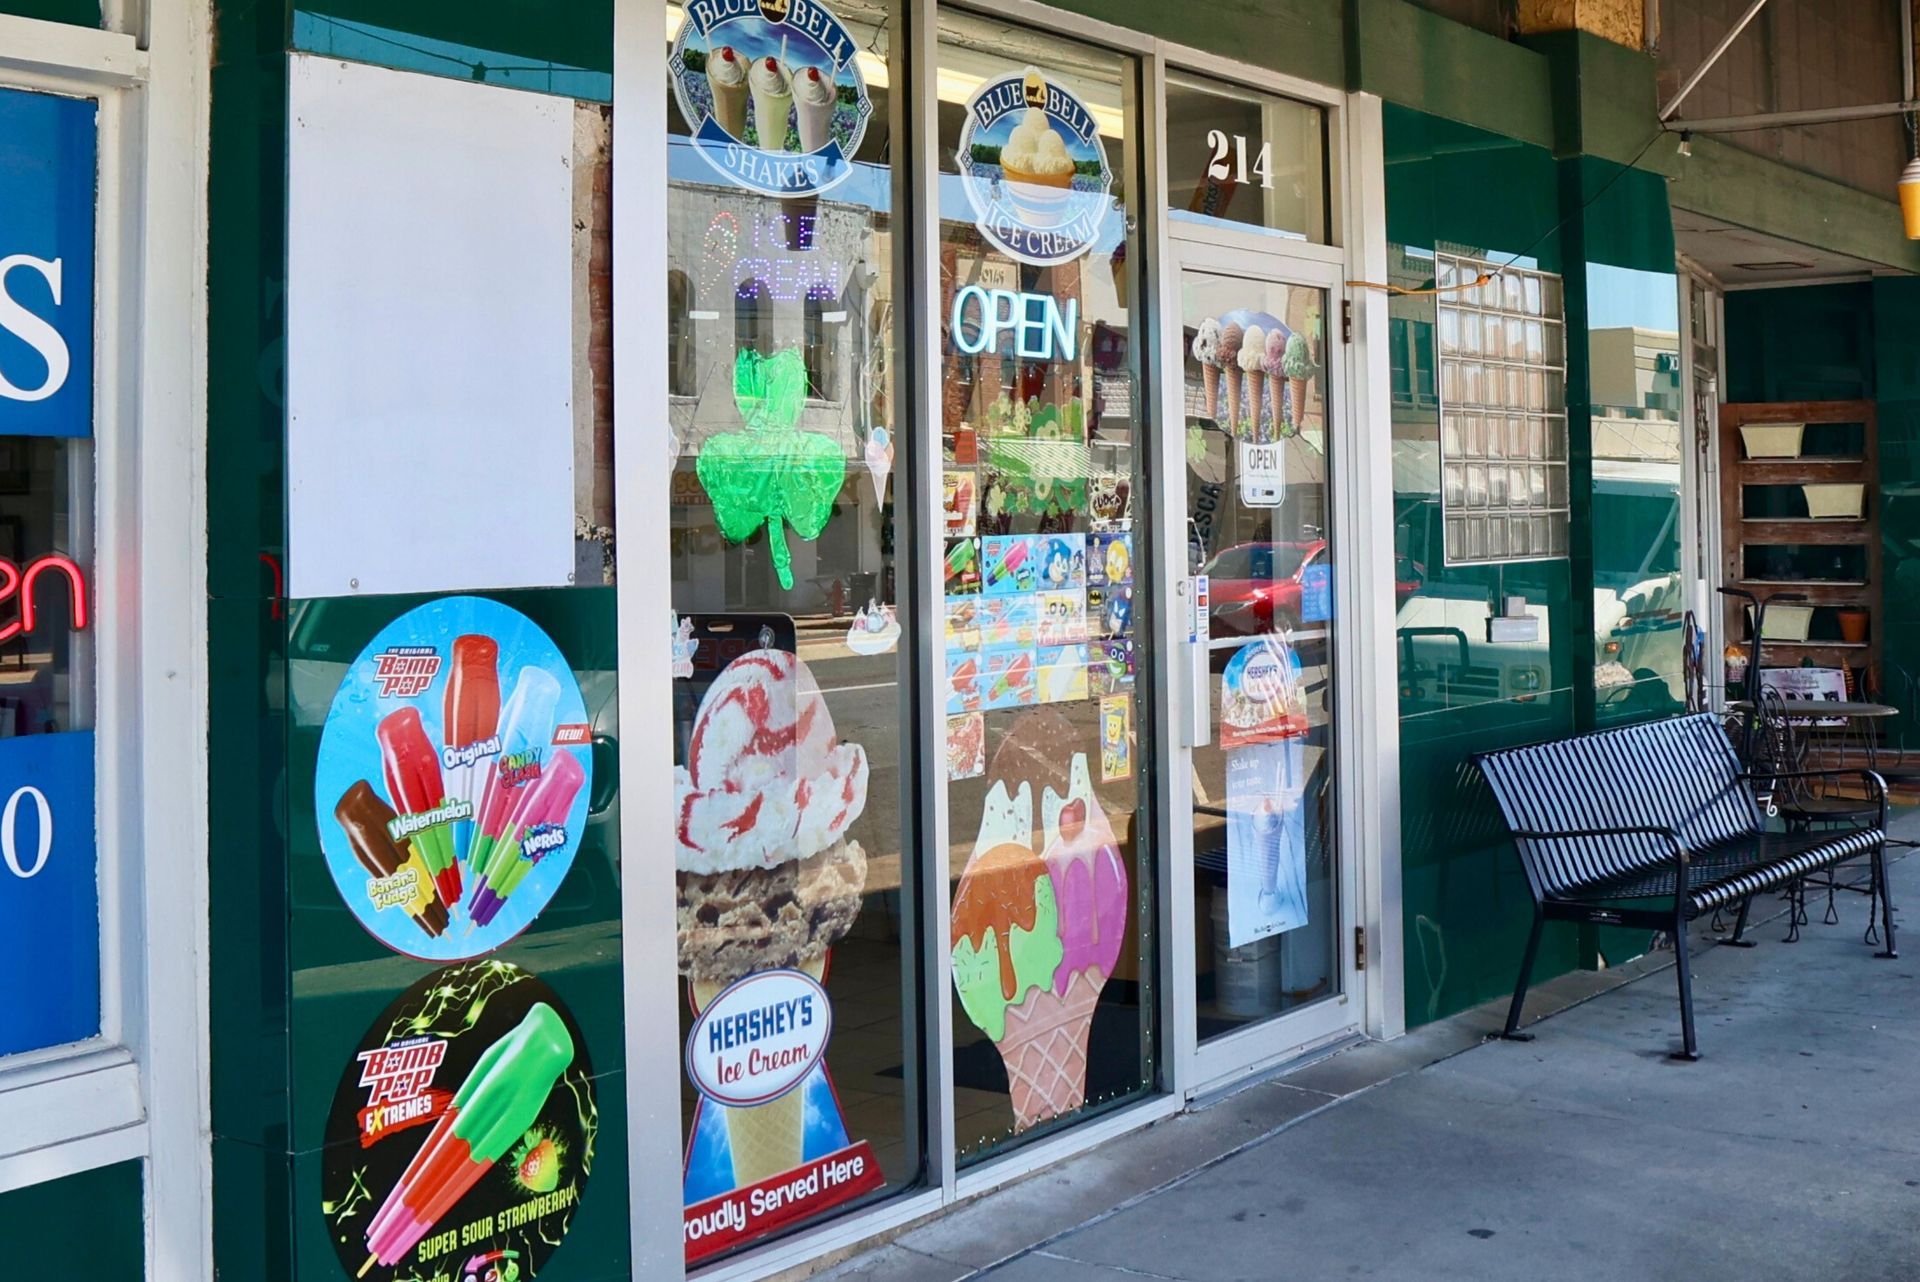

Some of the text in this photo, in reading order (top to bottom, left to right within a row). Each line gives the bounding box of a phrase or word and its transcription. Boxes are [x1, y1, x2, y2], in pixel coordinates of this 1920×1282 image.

[693, 0, 846, 62] BLUE BELL
[975, 82, 1093, 141] BLUE BELL
[724, 142, 820, 188] SHAKES
[1207, 129, 1275, 190] 214
[755, 213, 820, 250] ICE
[987, 205, 1094, 255] ICE CREAM
[733, 257, 838, 300] CREAM
[952, 285, 1077, 361] OPEN
[1249, 448, 1277, 470] OPEN
[377, 676, 430, 695] POP
[444, 736, 500, 768] Original
[389, 801, 471, 840] Watermelon
[369, 870, 417, 897] Banana
[709, 994, 813, 1053] HERSHEY'S
[717, 1043, 811, 1085] Ice Cream
[360, 1069, 434, 1104] POP
[365, 1094, 432, 1135] EXTREMES
[684, 1199, 746, 1243] roudly
[751, 1168, 818, 1218] Served
[822, 1156, 864, 1189] Here
[418, 1186, 575, 1263] SUPER SOUR STRAWBERRY
